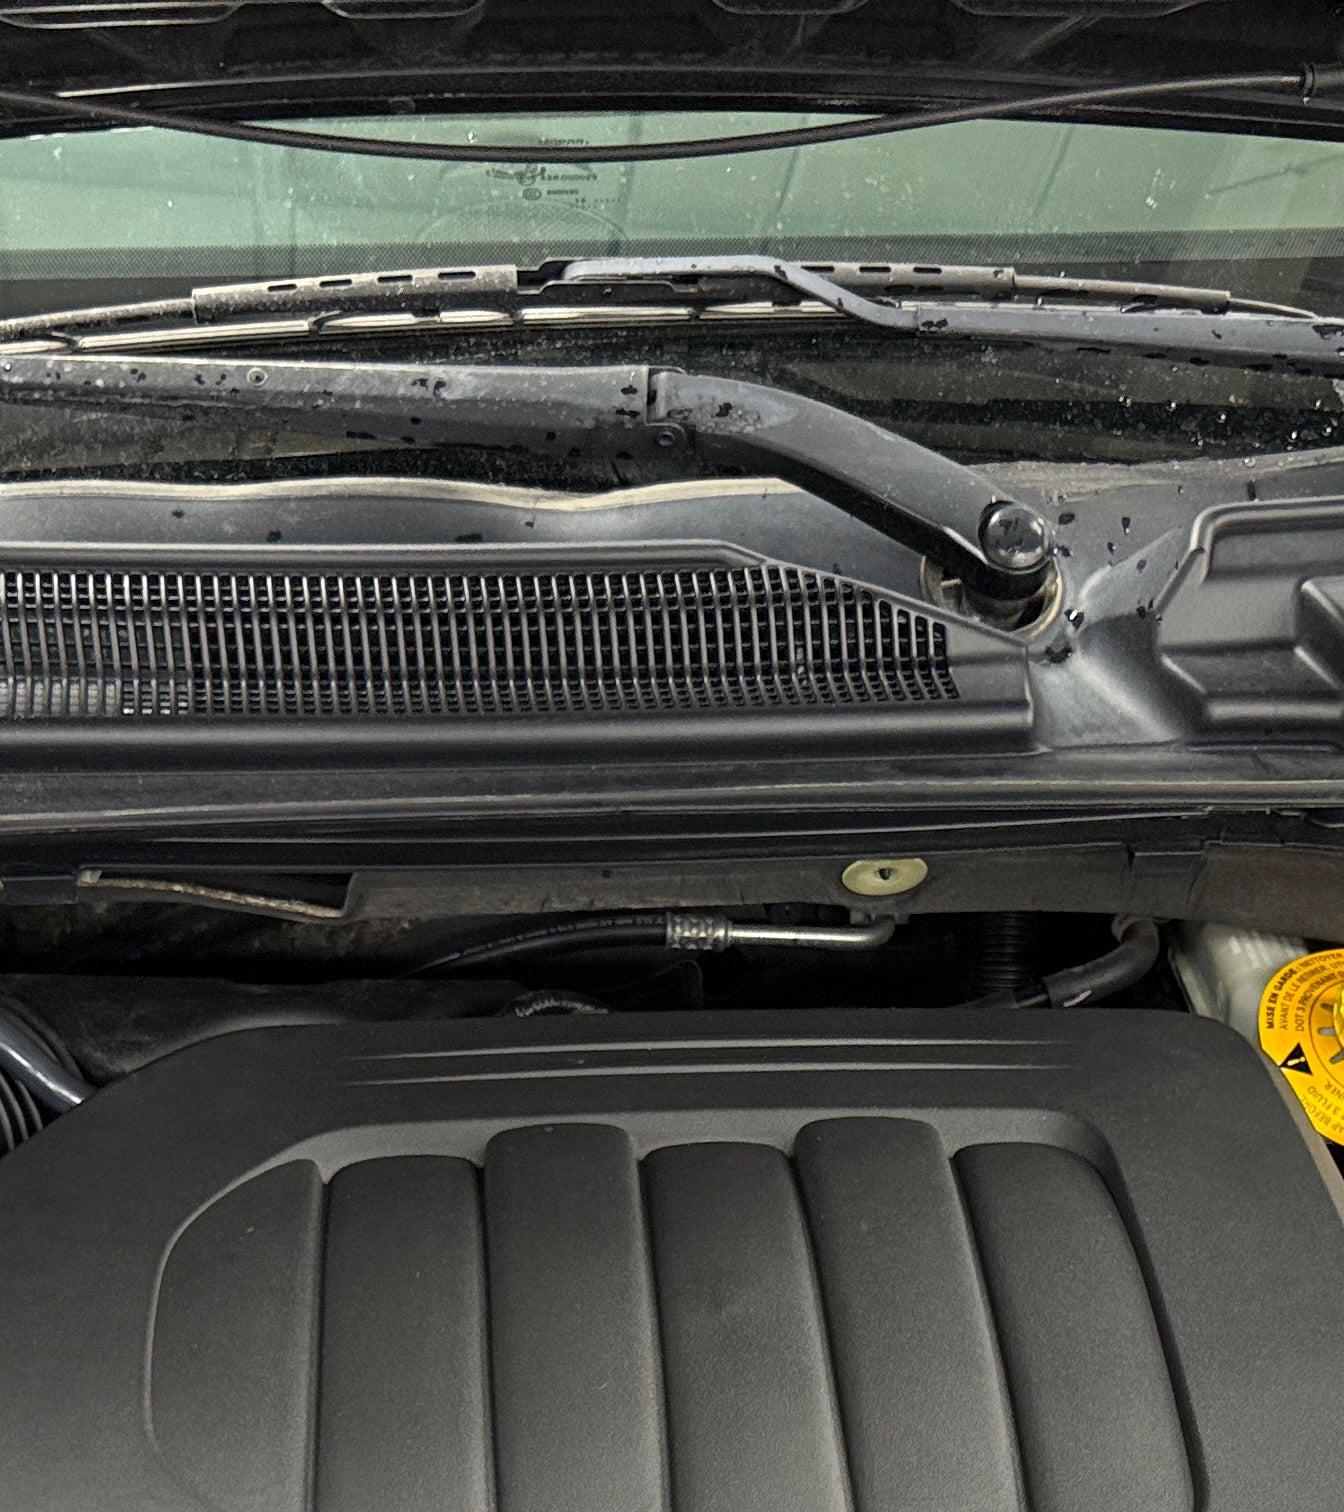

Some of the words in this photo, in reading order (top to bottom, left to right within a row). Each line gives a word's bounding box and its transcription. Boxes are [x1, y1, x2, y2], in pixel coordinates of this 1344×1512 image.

[1268, 992, 1279, 1004] EN
[1266, 1005, 1276, 1029] MISE
[1294, 1013, 1306, 1032] DOT
[1306, 1085, 1333, 1111] FLUID
[1331, 1104, 1341, 1116] 3
